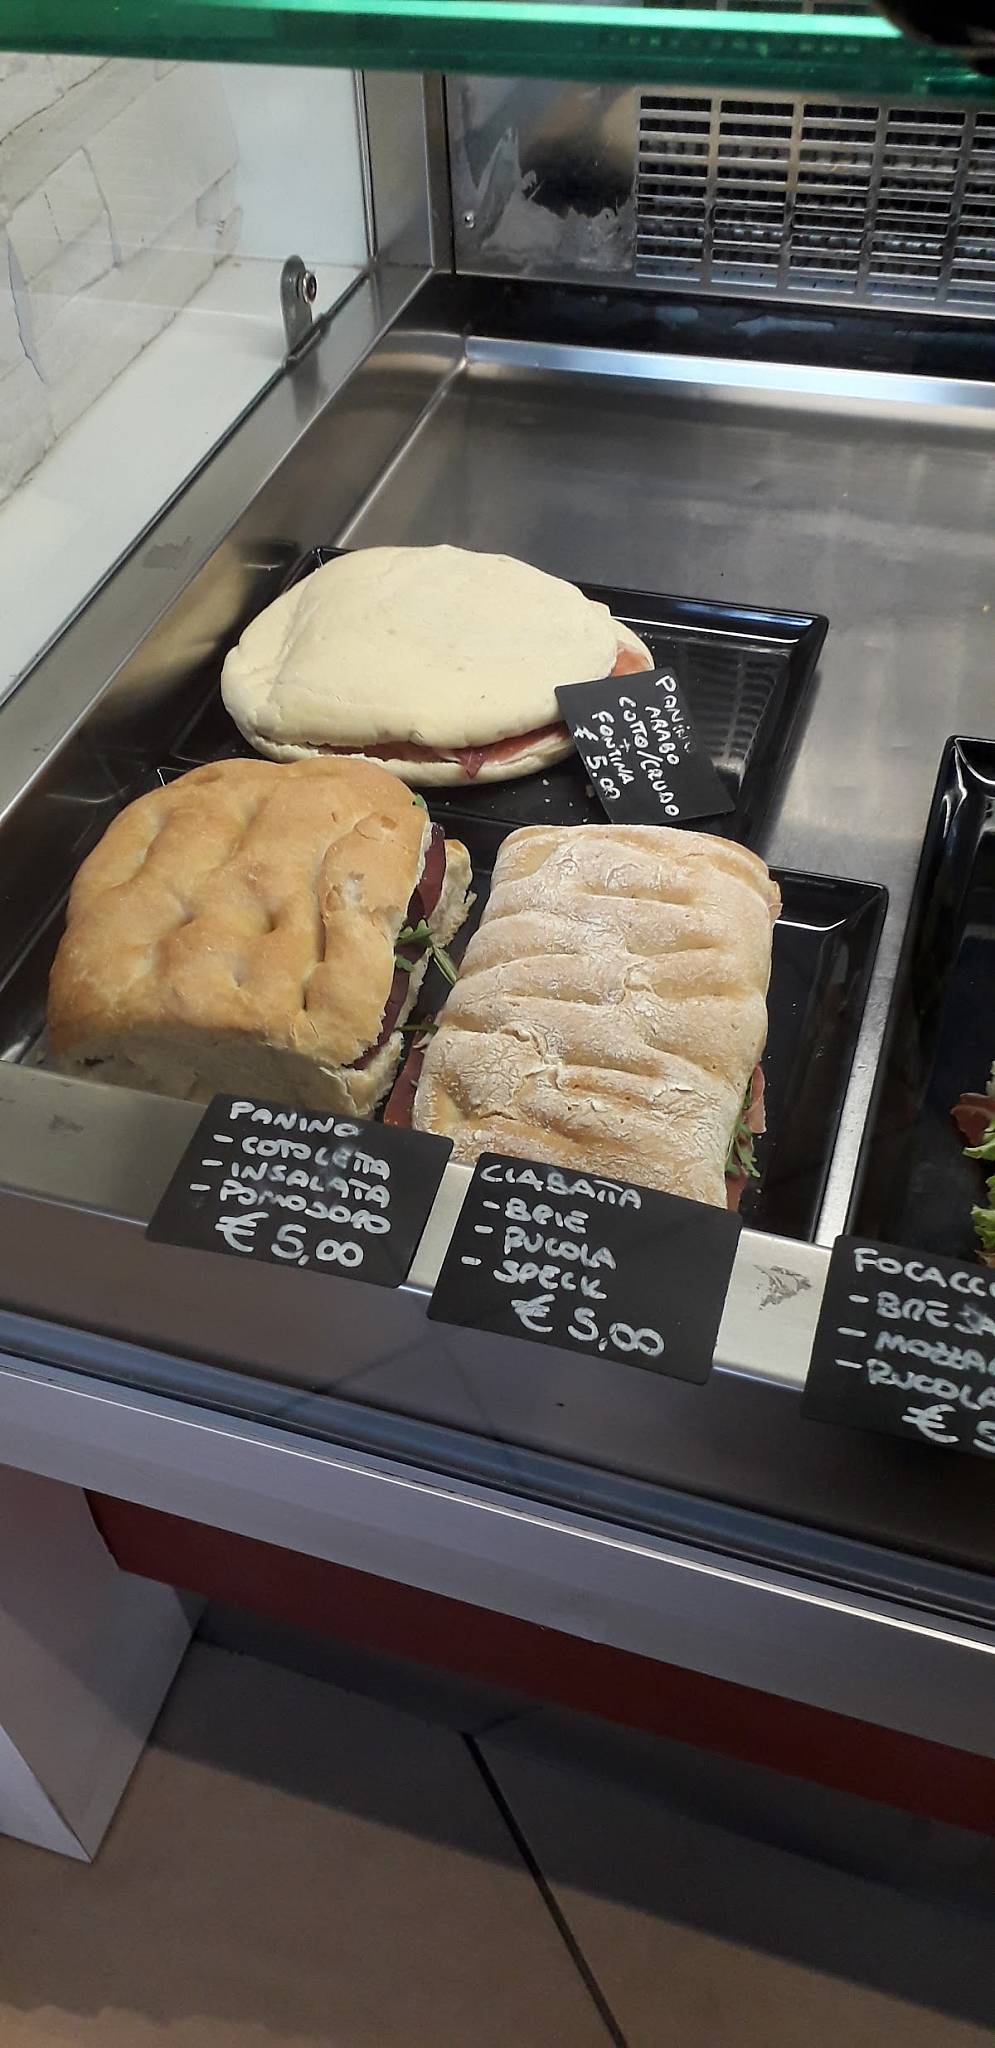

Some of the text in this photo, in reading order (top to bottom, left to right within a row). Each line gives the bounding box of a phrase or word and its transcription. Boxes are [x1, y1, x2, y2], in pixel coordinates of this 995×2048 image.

[592, 711, 635, 785] FONTINA
[645, 706, 680, 765] ARABO
[229, 1101, 363, 1138] PANINO
[231, 1162, 391, 1208] INSALATA
[480, 1164, 643, 1211] CIABATTA
[504, 1197, 590, 1234] BRIE
[214, 1211, 364, 1268] € 5,00
[503, 1226, 617, 1270] RUCOLA
[493, 1259, 608, 1300] SPECK
[511, 1294, 665, 1356] € 5,00
[901, 1403, 960, 1444] €
